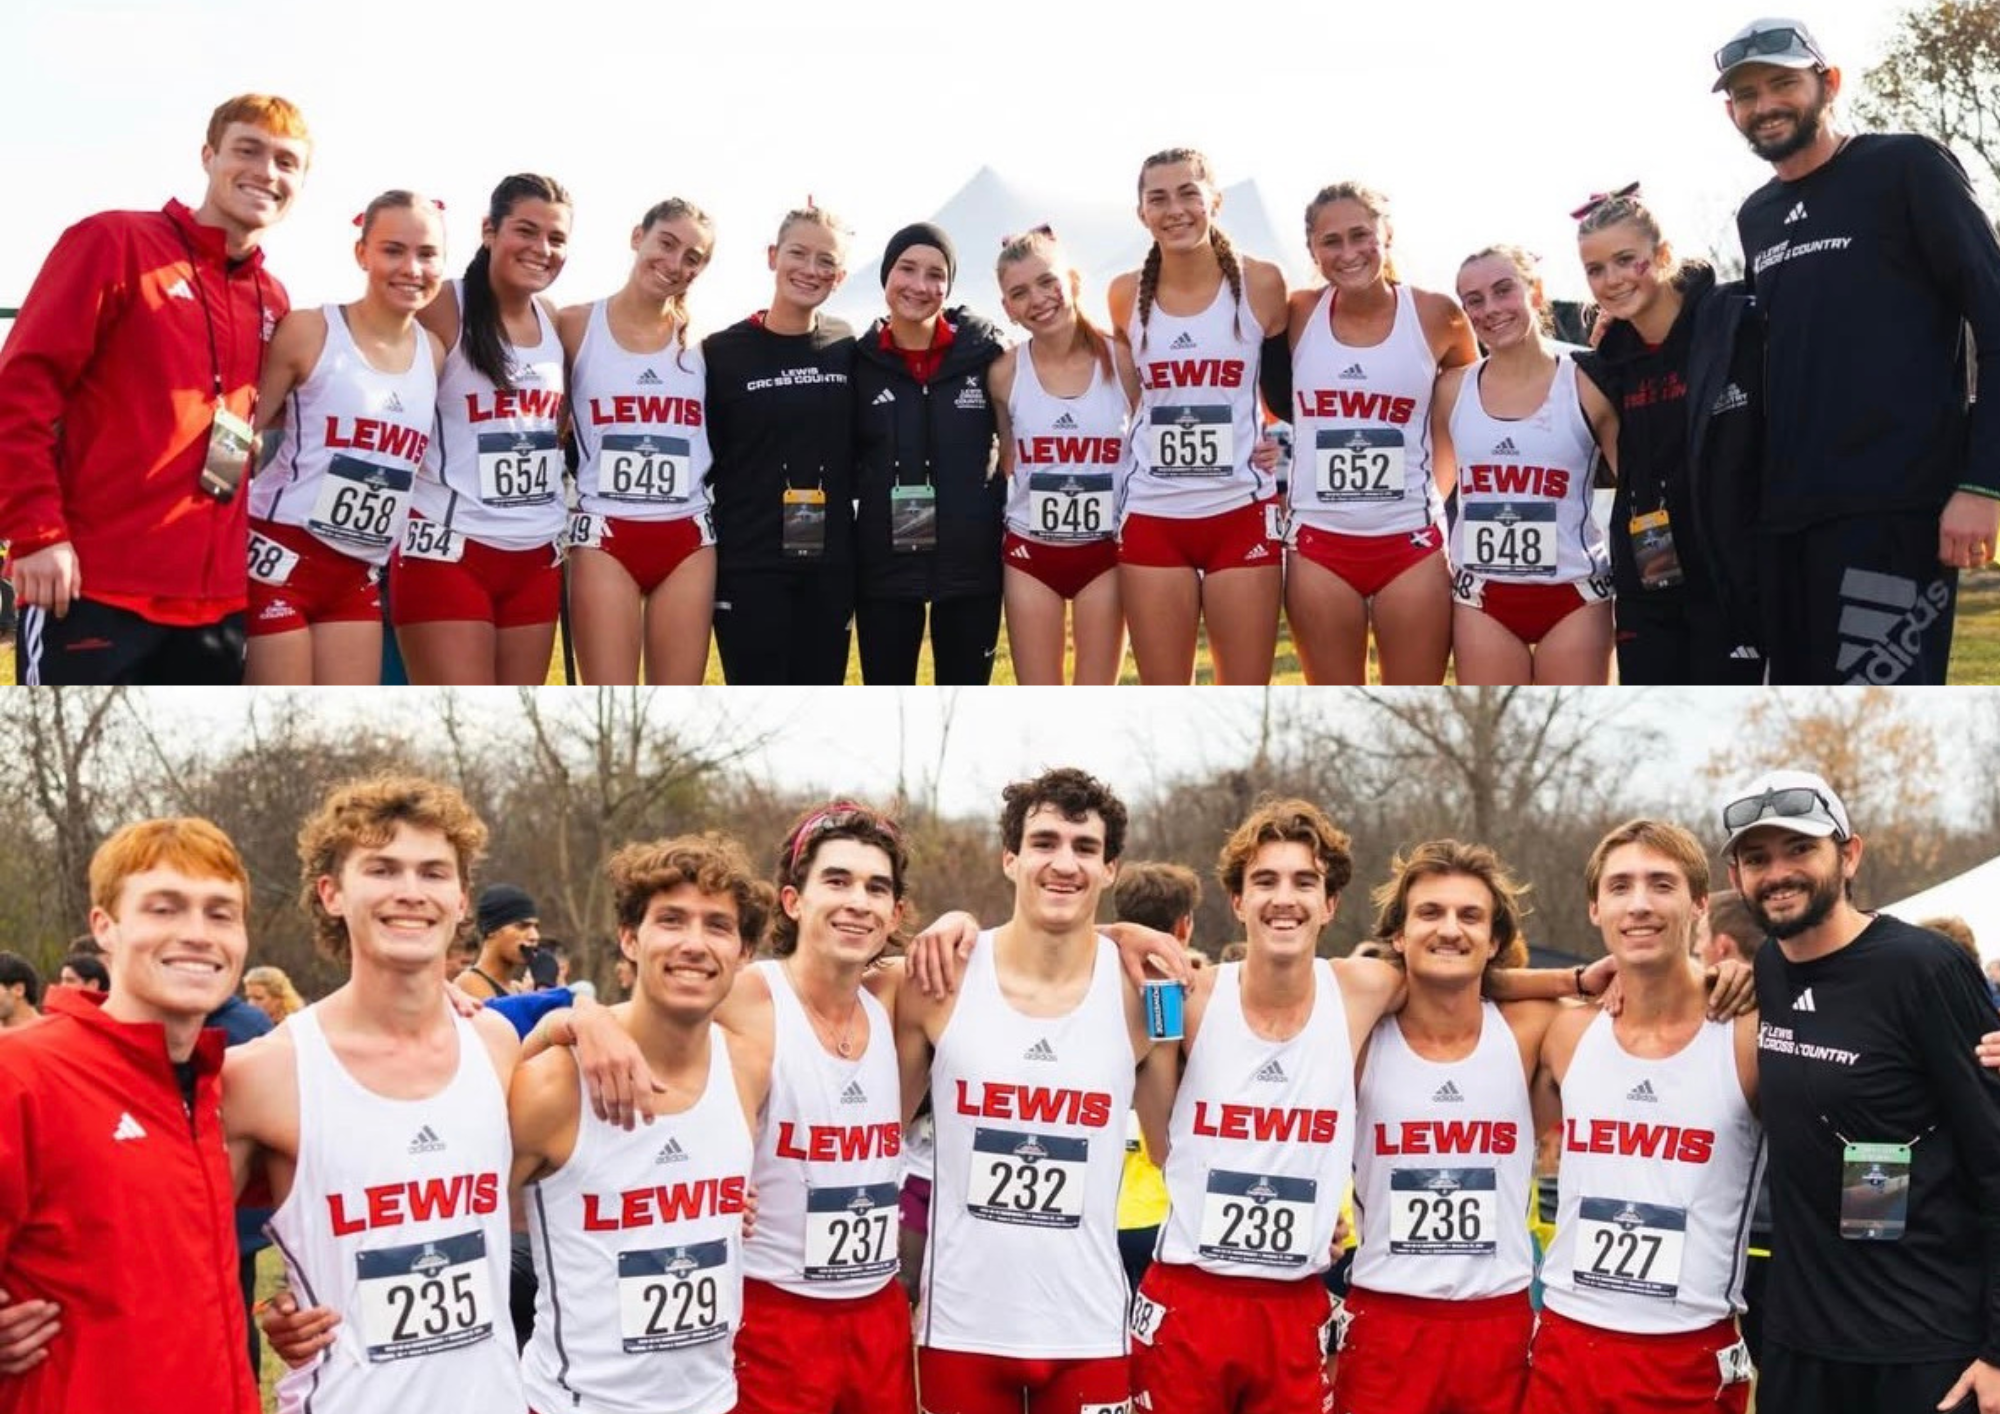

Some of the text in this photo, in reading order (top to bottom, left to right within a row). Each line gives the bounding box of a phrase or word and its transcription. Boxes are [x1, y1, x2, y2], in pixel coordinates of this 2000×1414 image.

[1792, 237, 1852, 258] COUNTRY
[591, 395, 702, 426] LEWIS
[1297, 390, 1416, 423] LEWIS
[1019, 437, 1120, 464] LEWIS
[1159, 430, 1219, 466] 655
[494, 458, 549, 496] 654
[612, 456, 677, 496] 649
[1327, 453, 1391, 490] 652
[1460, 464, 1570, 498] LEWIS
[329, 486, 398, 535] 658
[1041, 496, 1102, 533] 646
[1476, 527, 1542, 565] 648
[1763, 1037, 1795, 1055] CROSS
[1768, 1026, 1794, 1041] LEWIS
[1023, 1052, 1058, 1062] adidas
[1256, 1073, 1289, 1084] adidas
[1627, 1092, 1659, 1103] adidas
[840, 1096, 868, 1104] adidas
[956, 1080, 1112, 1128] LEWIS
[1193, 1101, 1339, 1144] LEWIS
[1375, 1120, 1518, 1156] LEWIS
[1566, 1118, 1716, 1165] LEWIS
[655, 1153, 689, 1164] adidas
[776, 1121, 901, 1163] LEWIS
[326, 1171, 498, 1238] LEWIS
[582, 1175, 746, 1232] LEWIS
[987, 1161, 1067, 1214] 232
[1218, 1202, 1295, 1253] 238
[1407, 1197, 1481, 1242] 236
[827, 1215, 889, 1266] 237
[1590, 1229, 1664, 1280] 227
[387, 1273, 478, 1343] 235
[643, 1277, 719, 1336] 229
